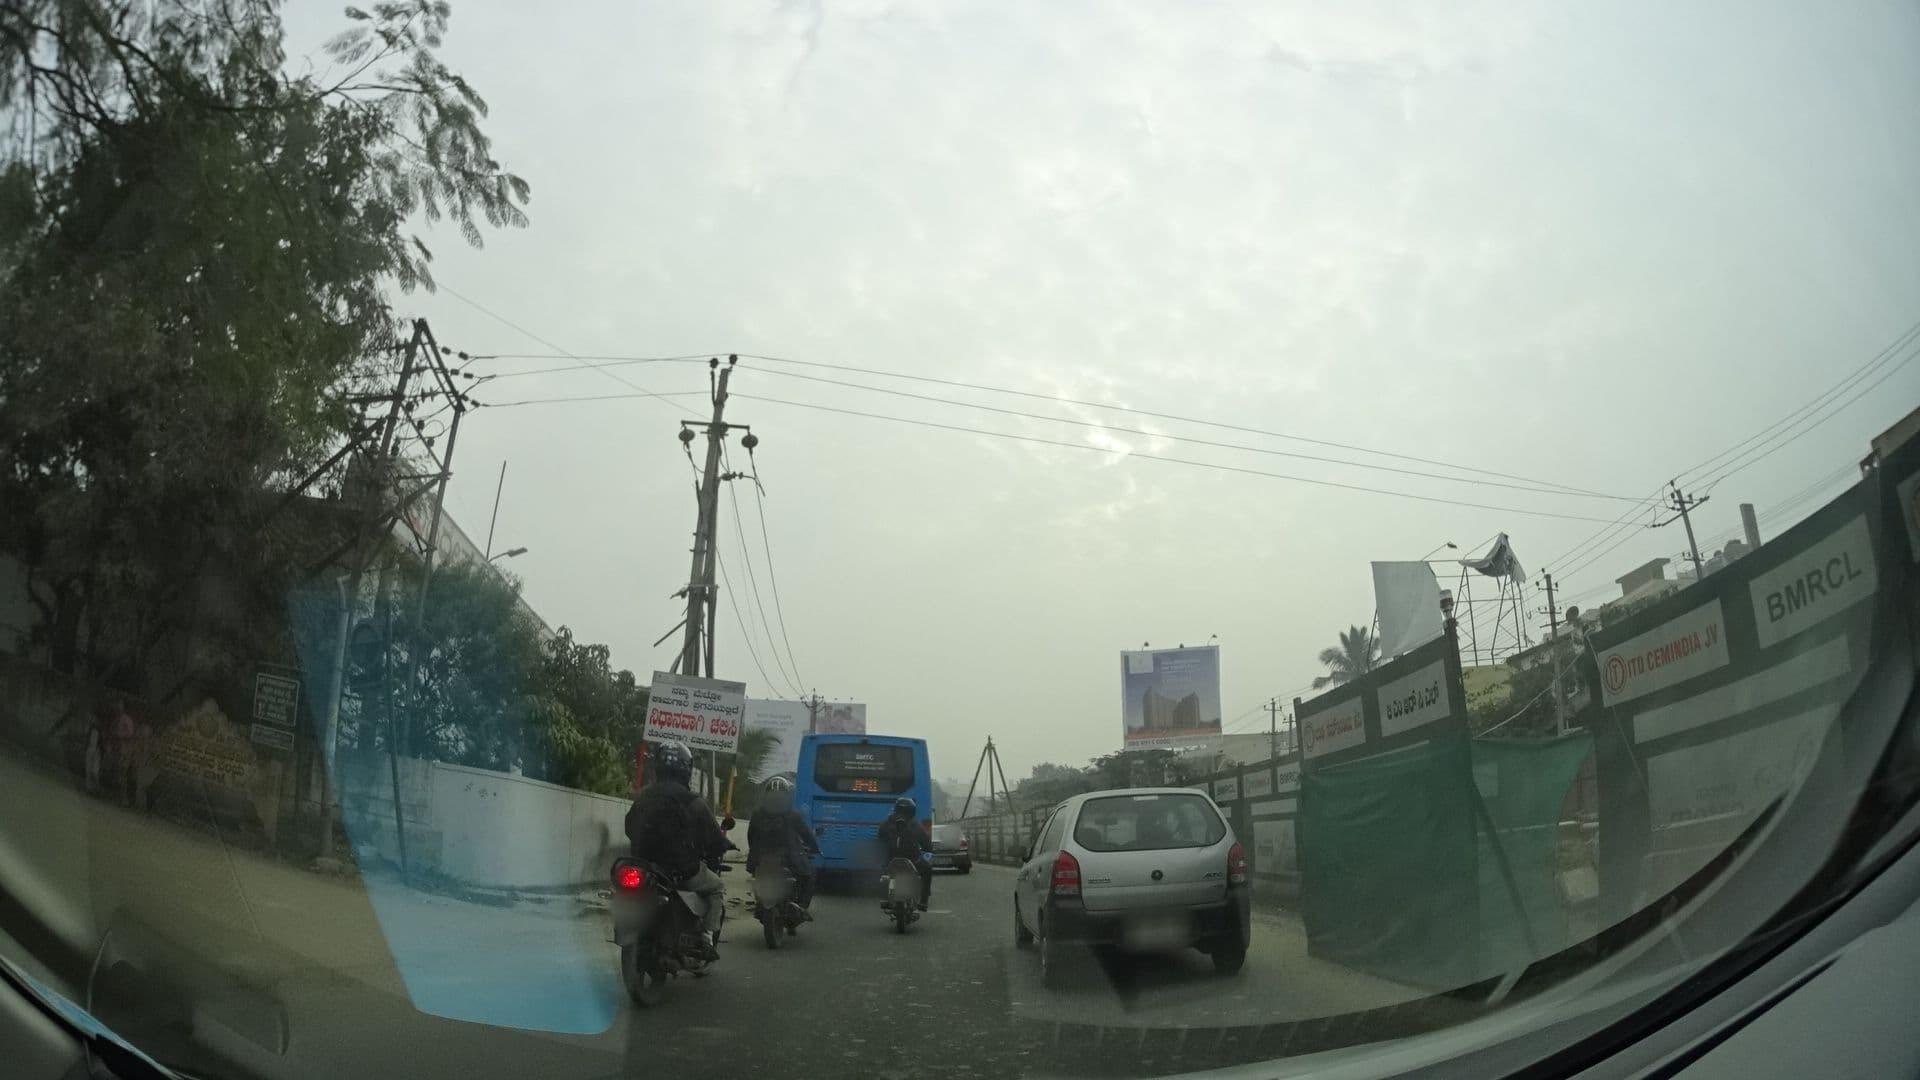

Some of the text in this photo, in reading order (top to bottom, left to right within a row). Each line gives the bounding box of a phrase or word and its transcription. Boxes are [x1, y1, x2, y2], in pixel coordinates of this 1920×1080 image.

[1766, 551, 1863, 623] BMRCL
[1626, 624, 1718, 679] ITD CEMINDIA JV
[649, 708, 705, 732] ನಿಧಾನವಾಗಿ
[710, 717, 738, 737] ಚಲಿಸಿ
